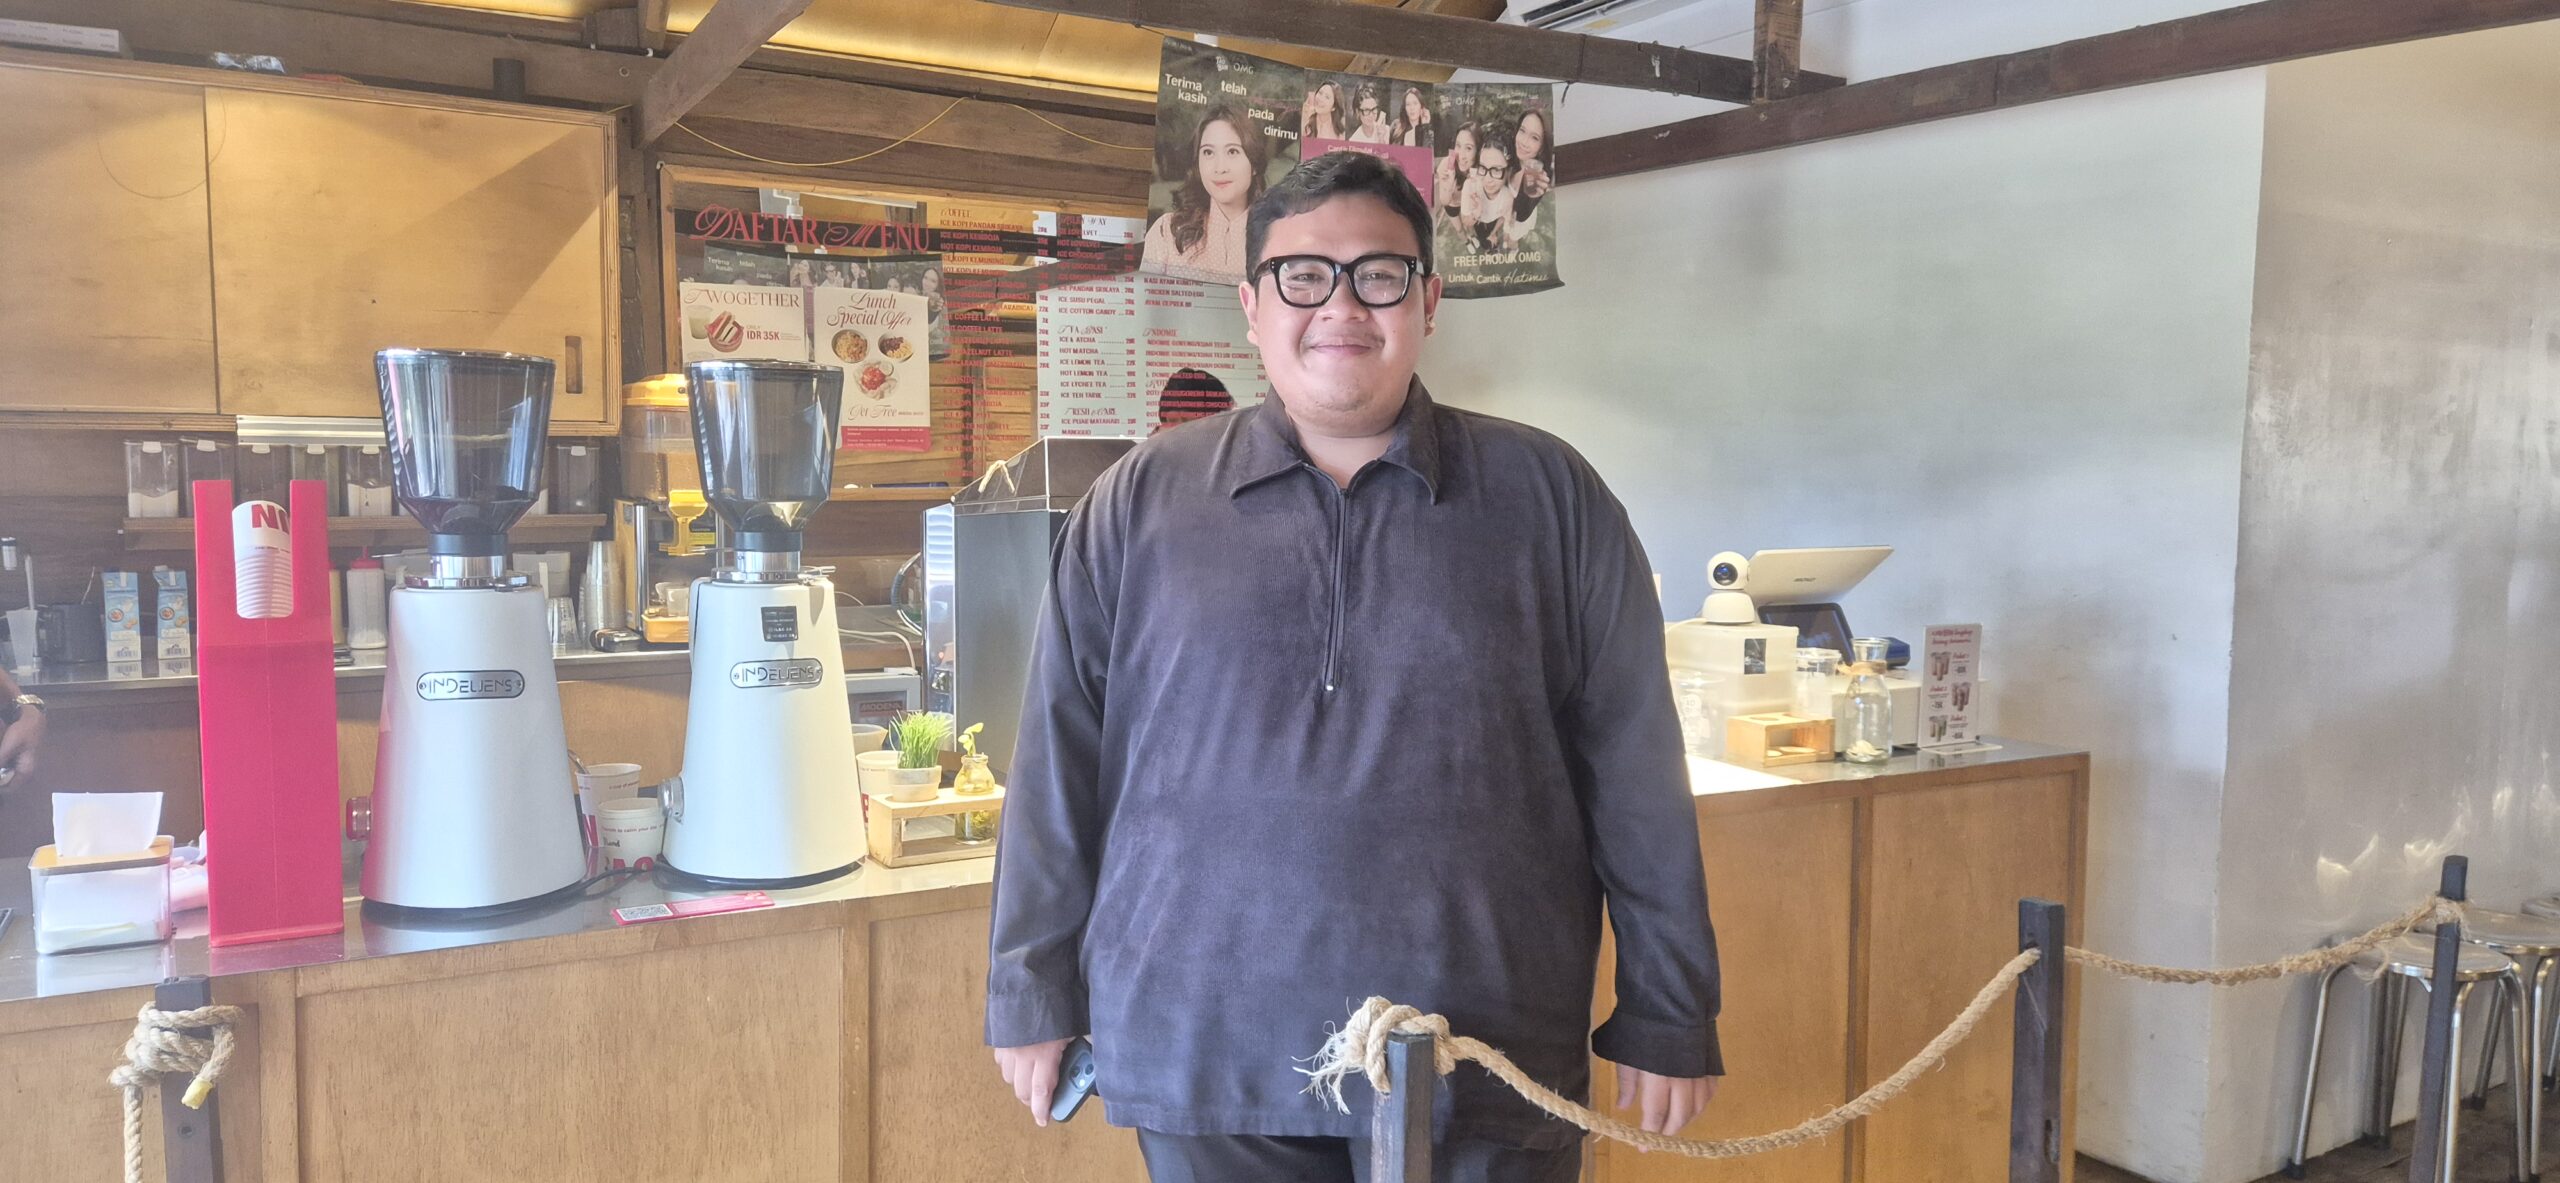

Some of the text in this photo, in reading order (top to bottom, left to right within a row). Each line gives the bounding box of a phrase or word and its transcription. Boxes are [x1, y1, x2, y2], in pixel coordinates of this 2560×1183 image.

[1233, 62, 1254, 75] OMG
[1165, 73, 1203, 91] Terima
[1221, 80, 1247, 96] telah
[1178, 89, 1208, 104] kasih
[1248, 108, 1275, 121] pada
[1264, 126, 1299, 140] dirimu
[689, 203, 930, 253] DAFTAR MENU
[952, 220, 968, 228] KOPI
[969, 221, 996, 230] PANDAN
[1453, 251, 1542, 268] FREE PRODUK OMG
[1448, 272, 1475, 283] Untuk
[1476, 273, 1503, 285] Cantik
[684, 288, 800, 308] TWOGETHER
[1171, 289, 1192, 297] SALTED
[849, 292, 897, 310] Lunch
[827, 306, 912, 330] Special Offer
[747, 330, 780, 341] IDR 35K
[848, 404, 898, 421] Get Free
